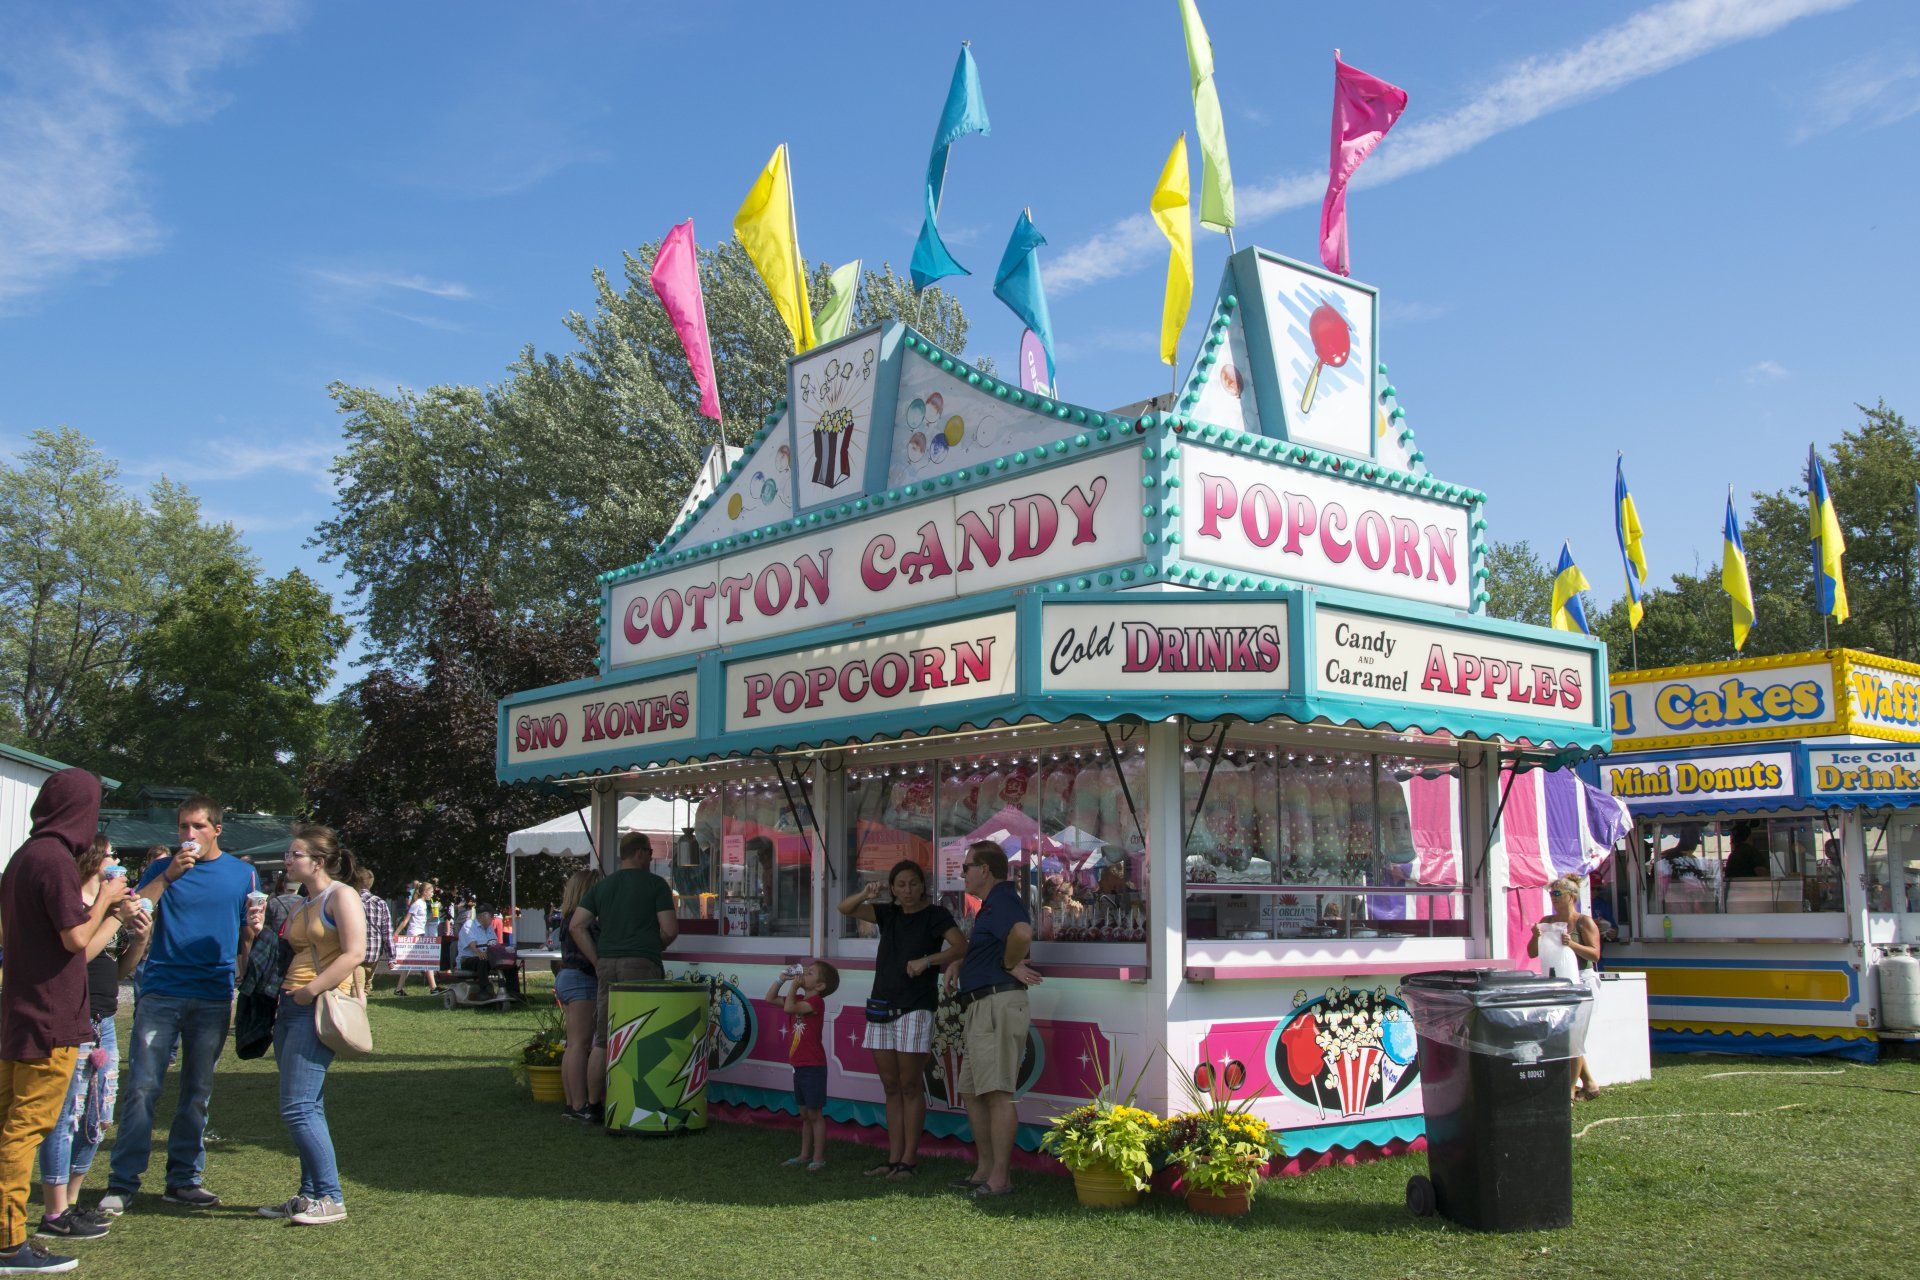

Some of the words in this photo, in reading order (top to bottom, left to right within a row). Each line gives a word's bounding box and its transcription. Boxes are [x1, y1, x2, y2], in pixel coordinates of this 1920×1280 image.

[1198, 472, 1457, 587] POPCORN
[623, 547, 833, 646] COTTON
[860, 475, 1108, 592] CANDY
[1050, 620, 1116, 677] Cold
[1122, 621, 1281, 674] DRINKS
[1334, 623, 1397, 660] Candy
[1357, 656, 1375, 665] AND
[742, 636, 997, 719] POPCORN
[1325, 659, 1409, 693] Caramel
[1420, 644, 1583, 710] APPLES
[515, 714, 568, 753] SNO
[581, 690, 690, 743] KONES
[1655, 678, 1826, 731] Cakes
[1609, 764, 1672, 798] Mini
[1675, 760, 1783, 794] Donuts
[1831, 753, 1862, 764] Ice
[1866, 751, 1916, 764] Cold
